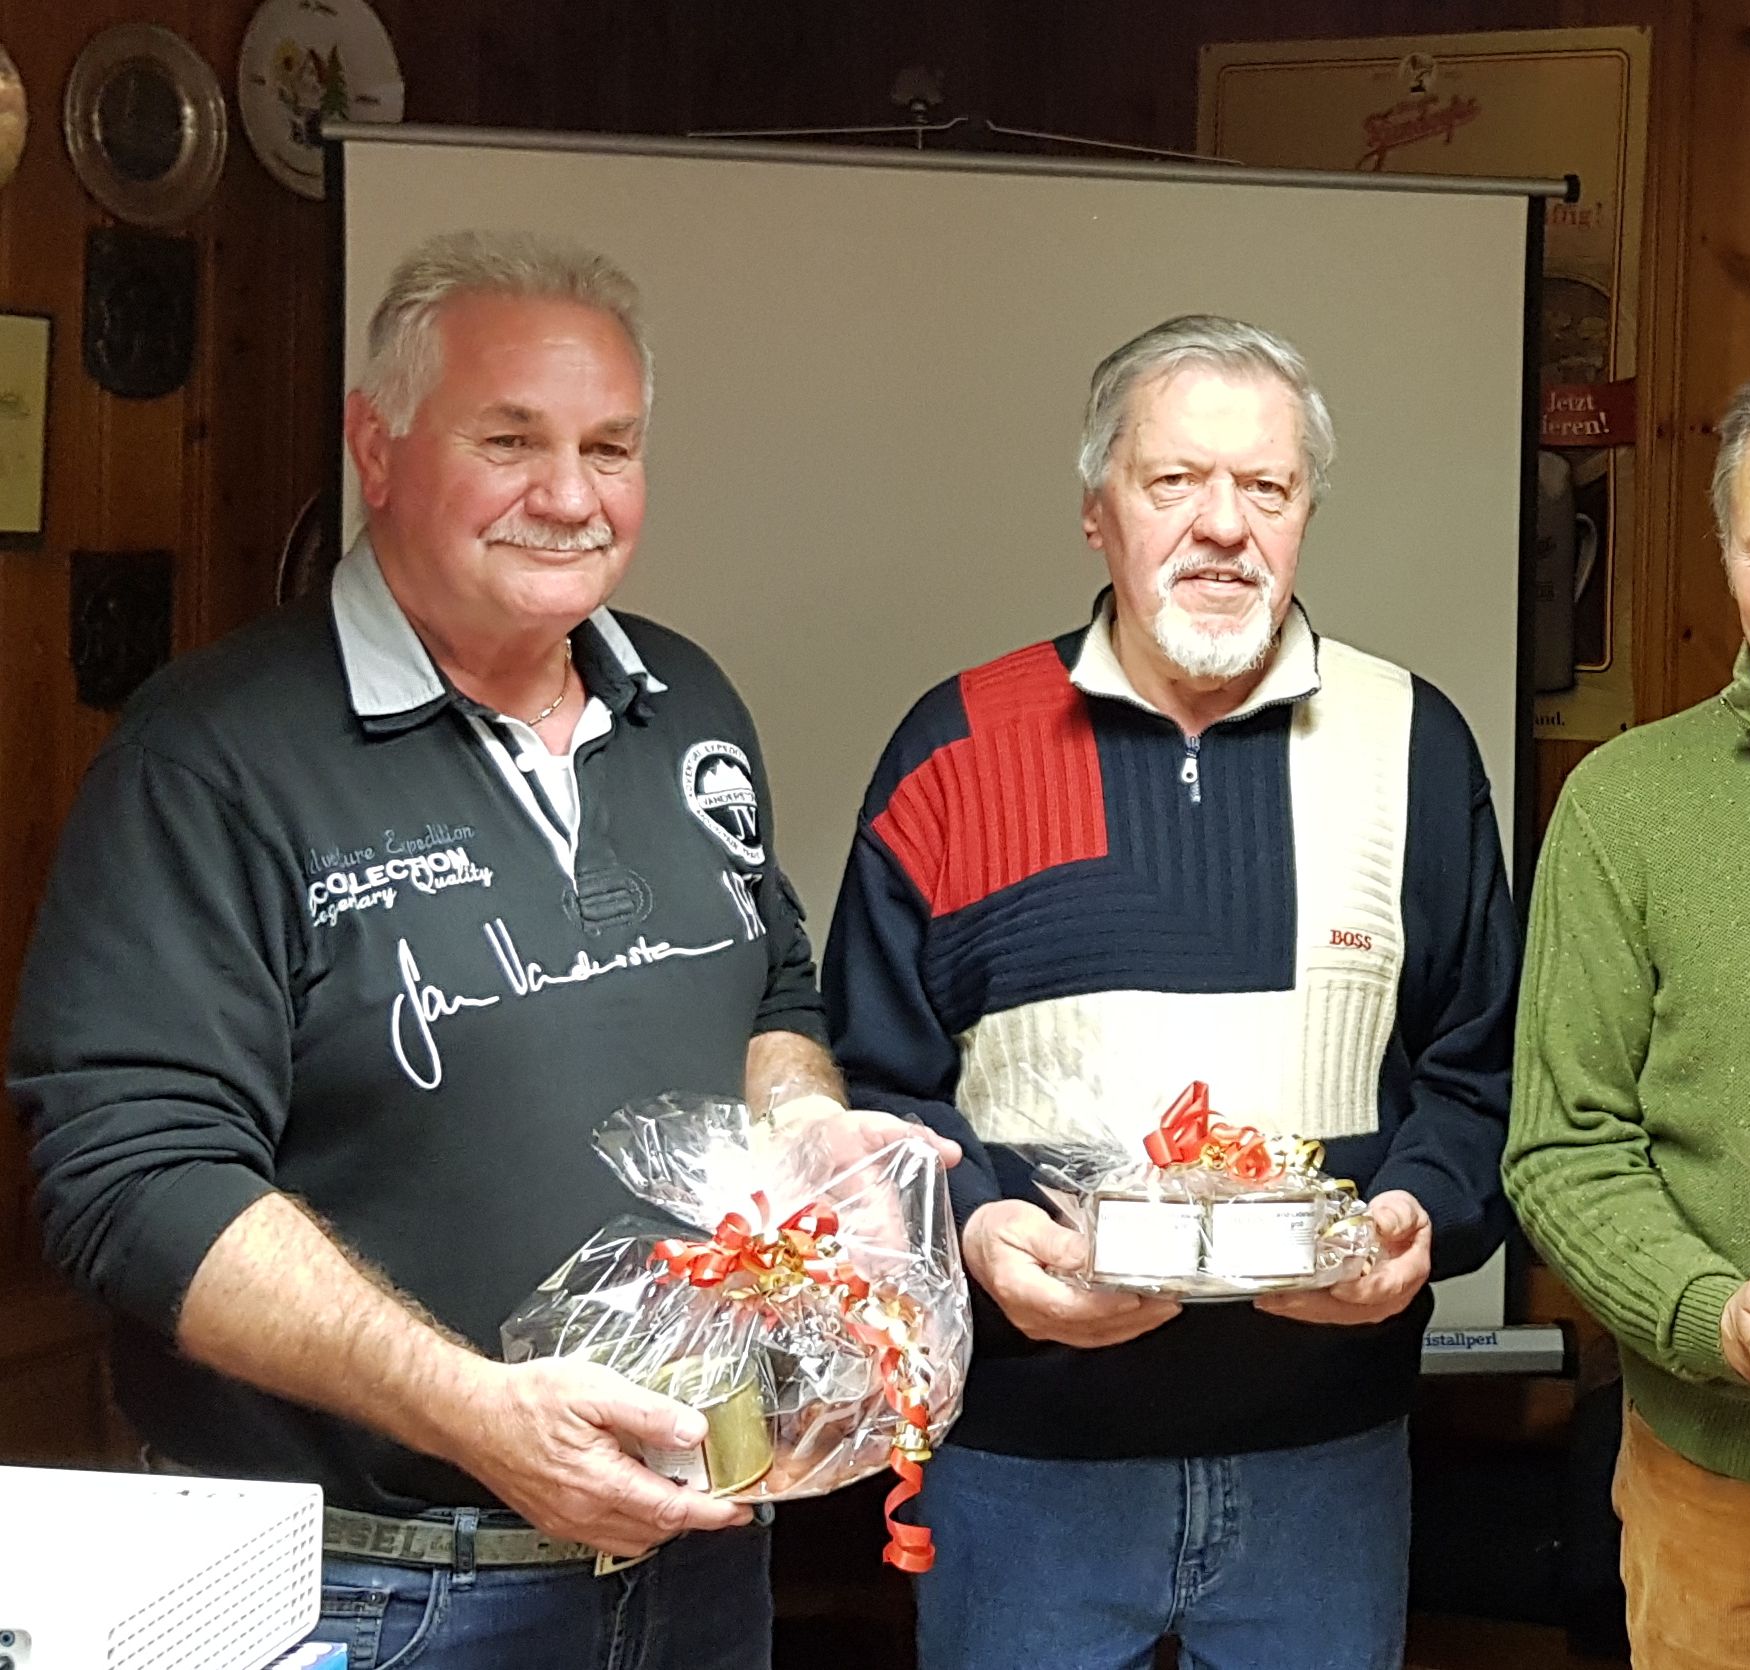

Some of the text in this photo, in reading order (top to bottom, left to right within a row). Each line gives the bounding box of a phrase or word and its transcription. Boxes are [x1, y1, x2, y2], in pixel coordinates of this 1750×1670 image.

[1547, 391, 1594, 413] Jetzt
[308, 846, 471, 905] COLECTION
[1328, 928, 1373, 952] BOSS
